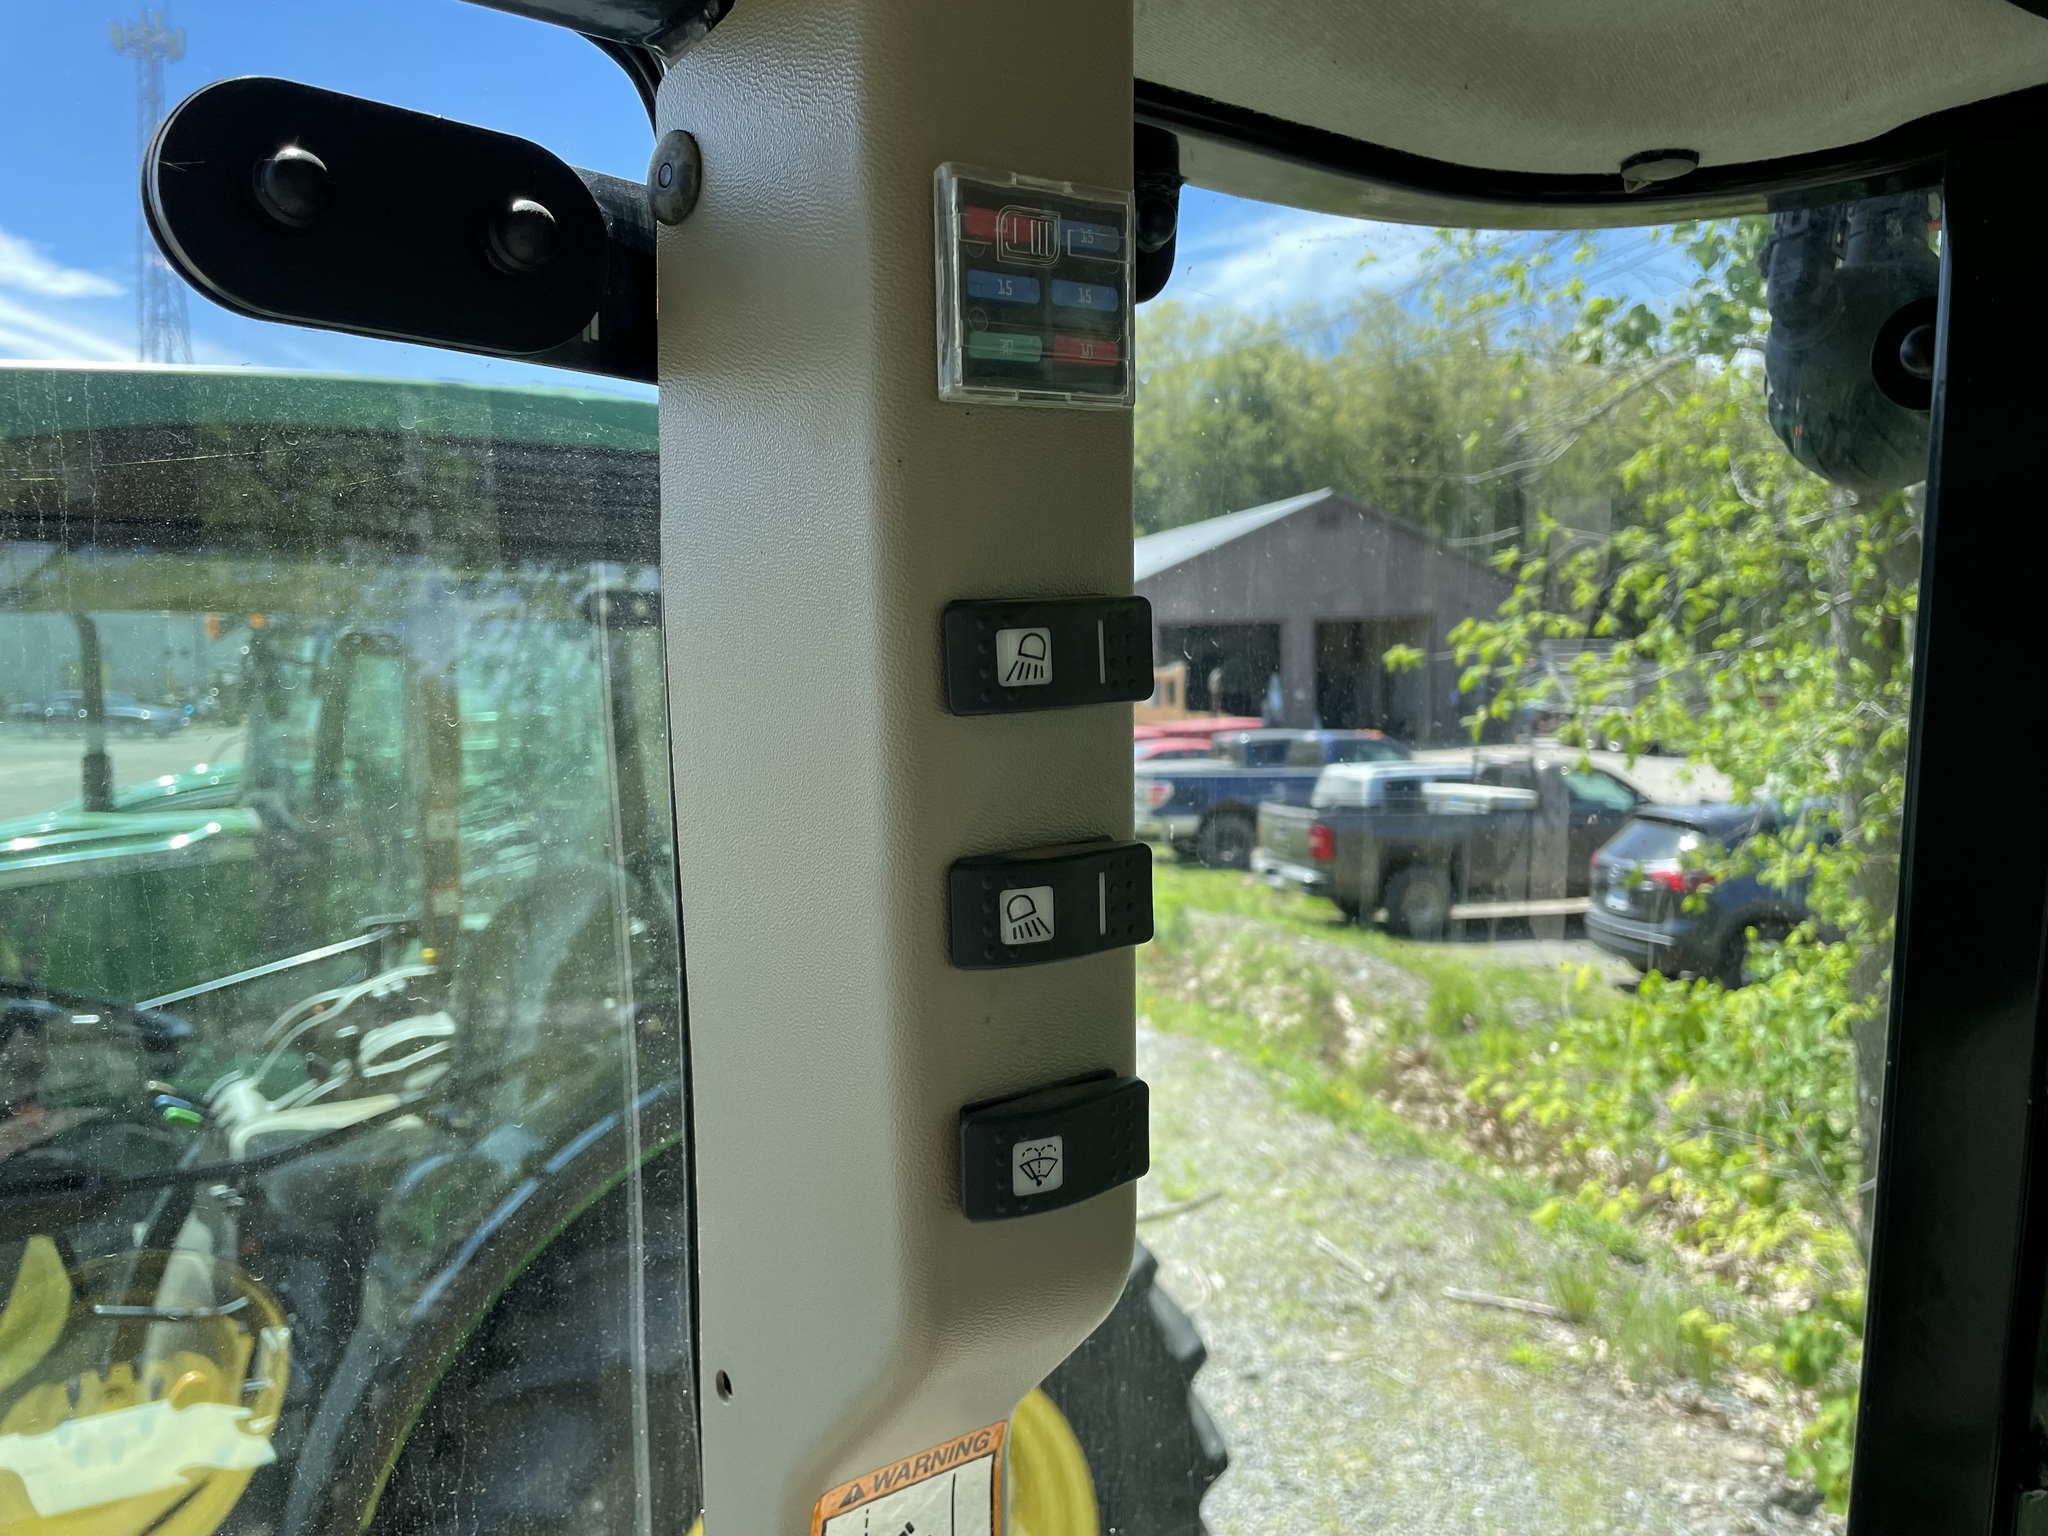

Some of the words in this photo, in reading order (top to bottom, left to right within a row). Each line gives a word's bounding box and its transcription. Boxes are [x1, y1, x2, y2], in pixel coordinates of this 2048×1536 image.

[1080, 228, 1094, 244] 15
[998, 279, 1013, 296] 15
[1078, 287, 1092, 304] 15
[999, 339, 1014, 355] 30
[1080, 343, 1094, 359] 10
[874, 1431, 991, 1492] WARNING
